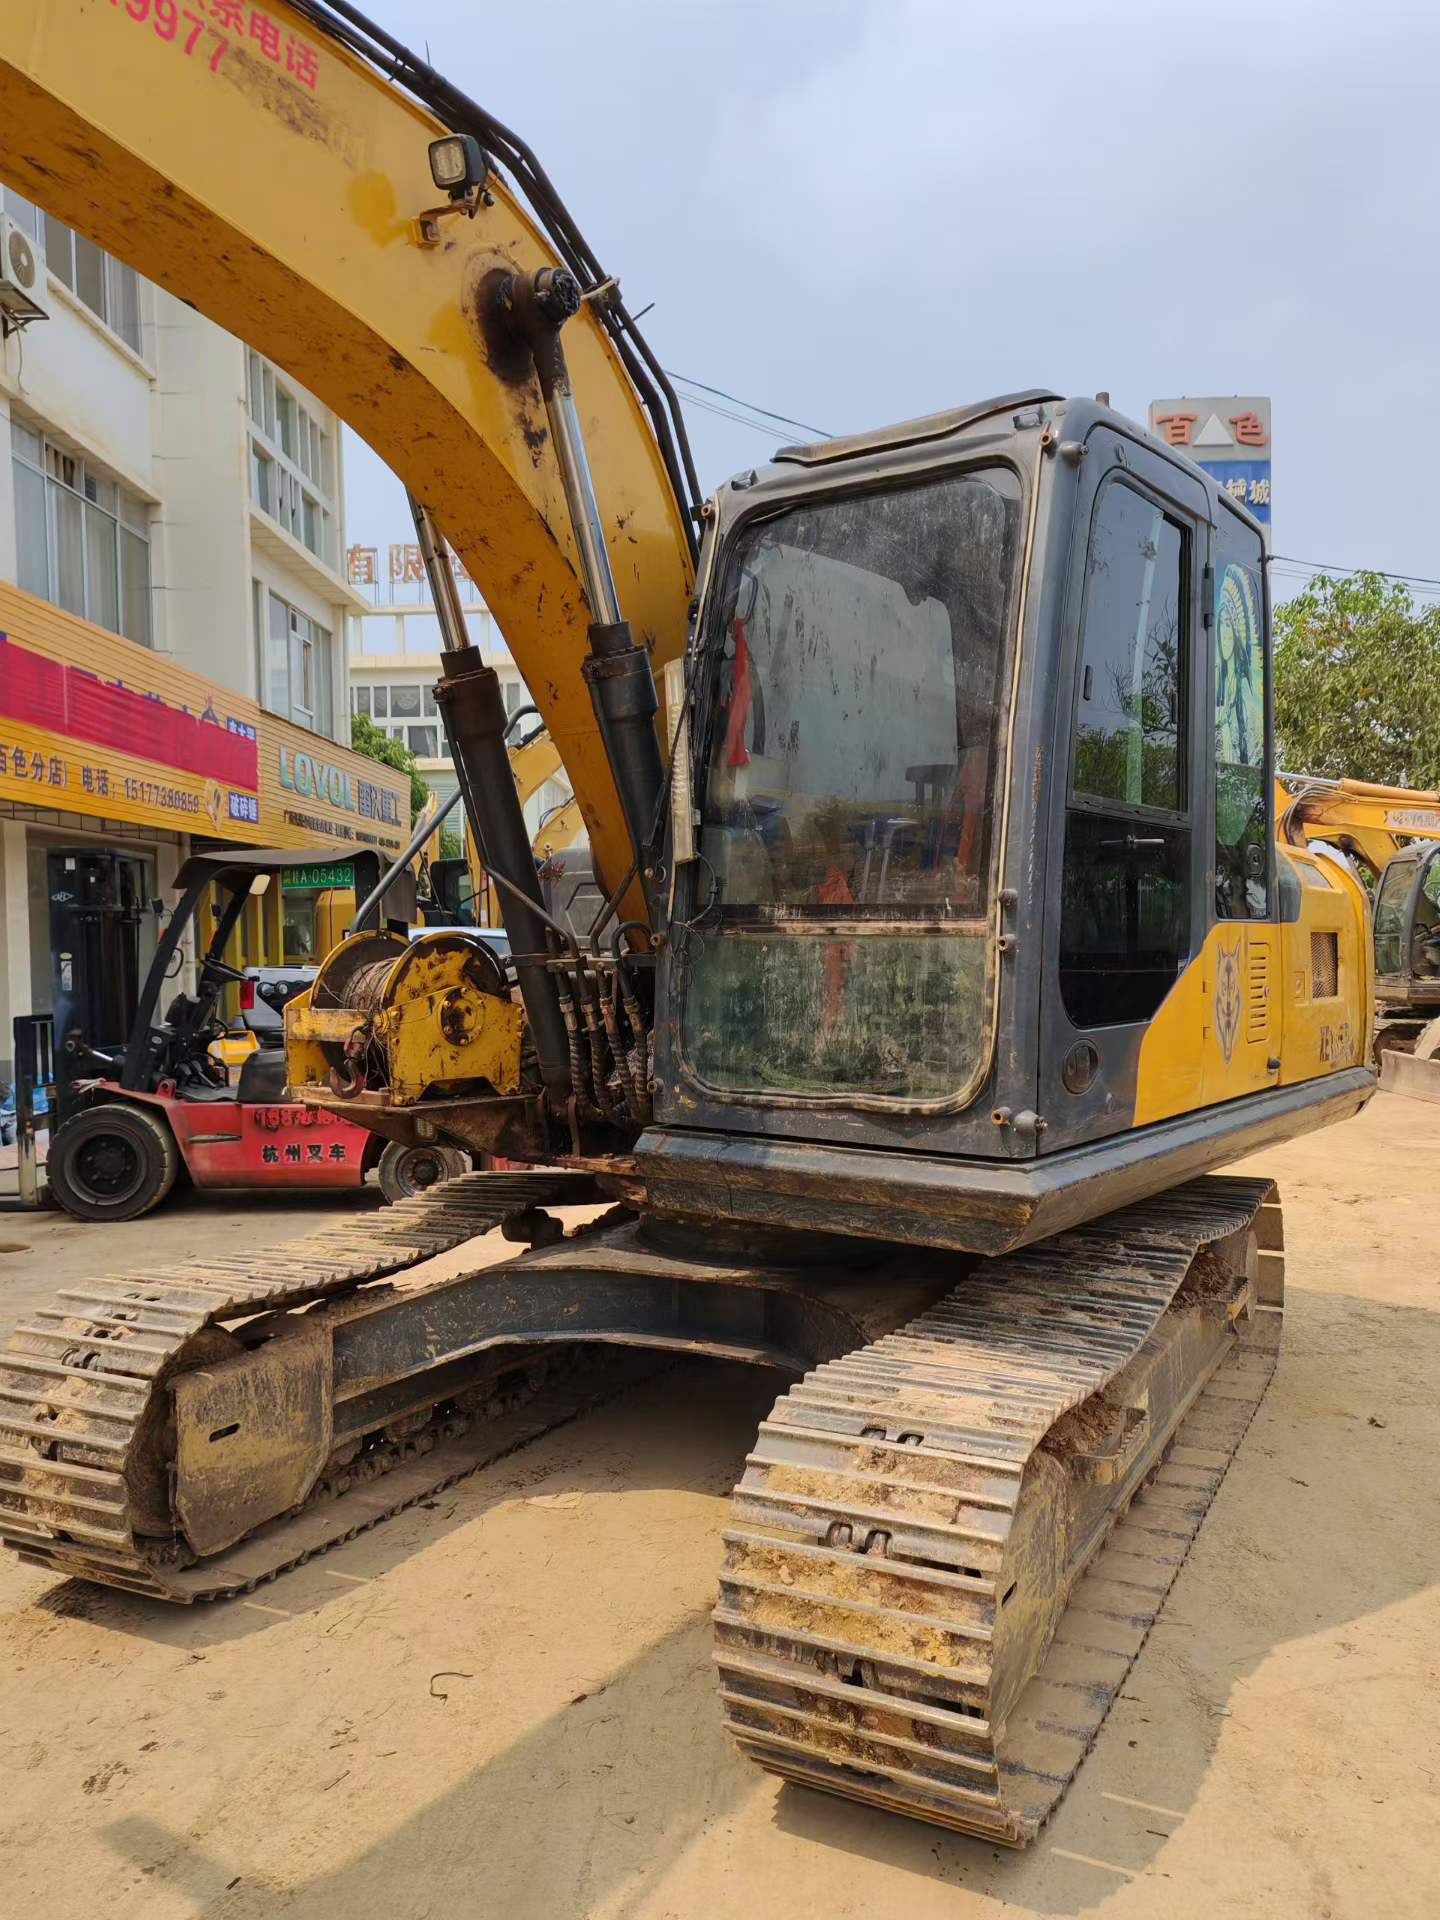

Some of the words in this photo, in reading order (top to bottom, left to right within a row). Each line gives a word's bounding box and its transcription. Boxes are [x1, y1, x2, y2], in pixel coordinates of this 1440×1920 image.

[110, 0, 229, 72] 9977
[198, 0, 319, 91] 系电话
[280, 745, 355, 812] LOVOL
[262, 1143, 346, 1164] 杭州叉车
